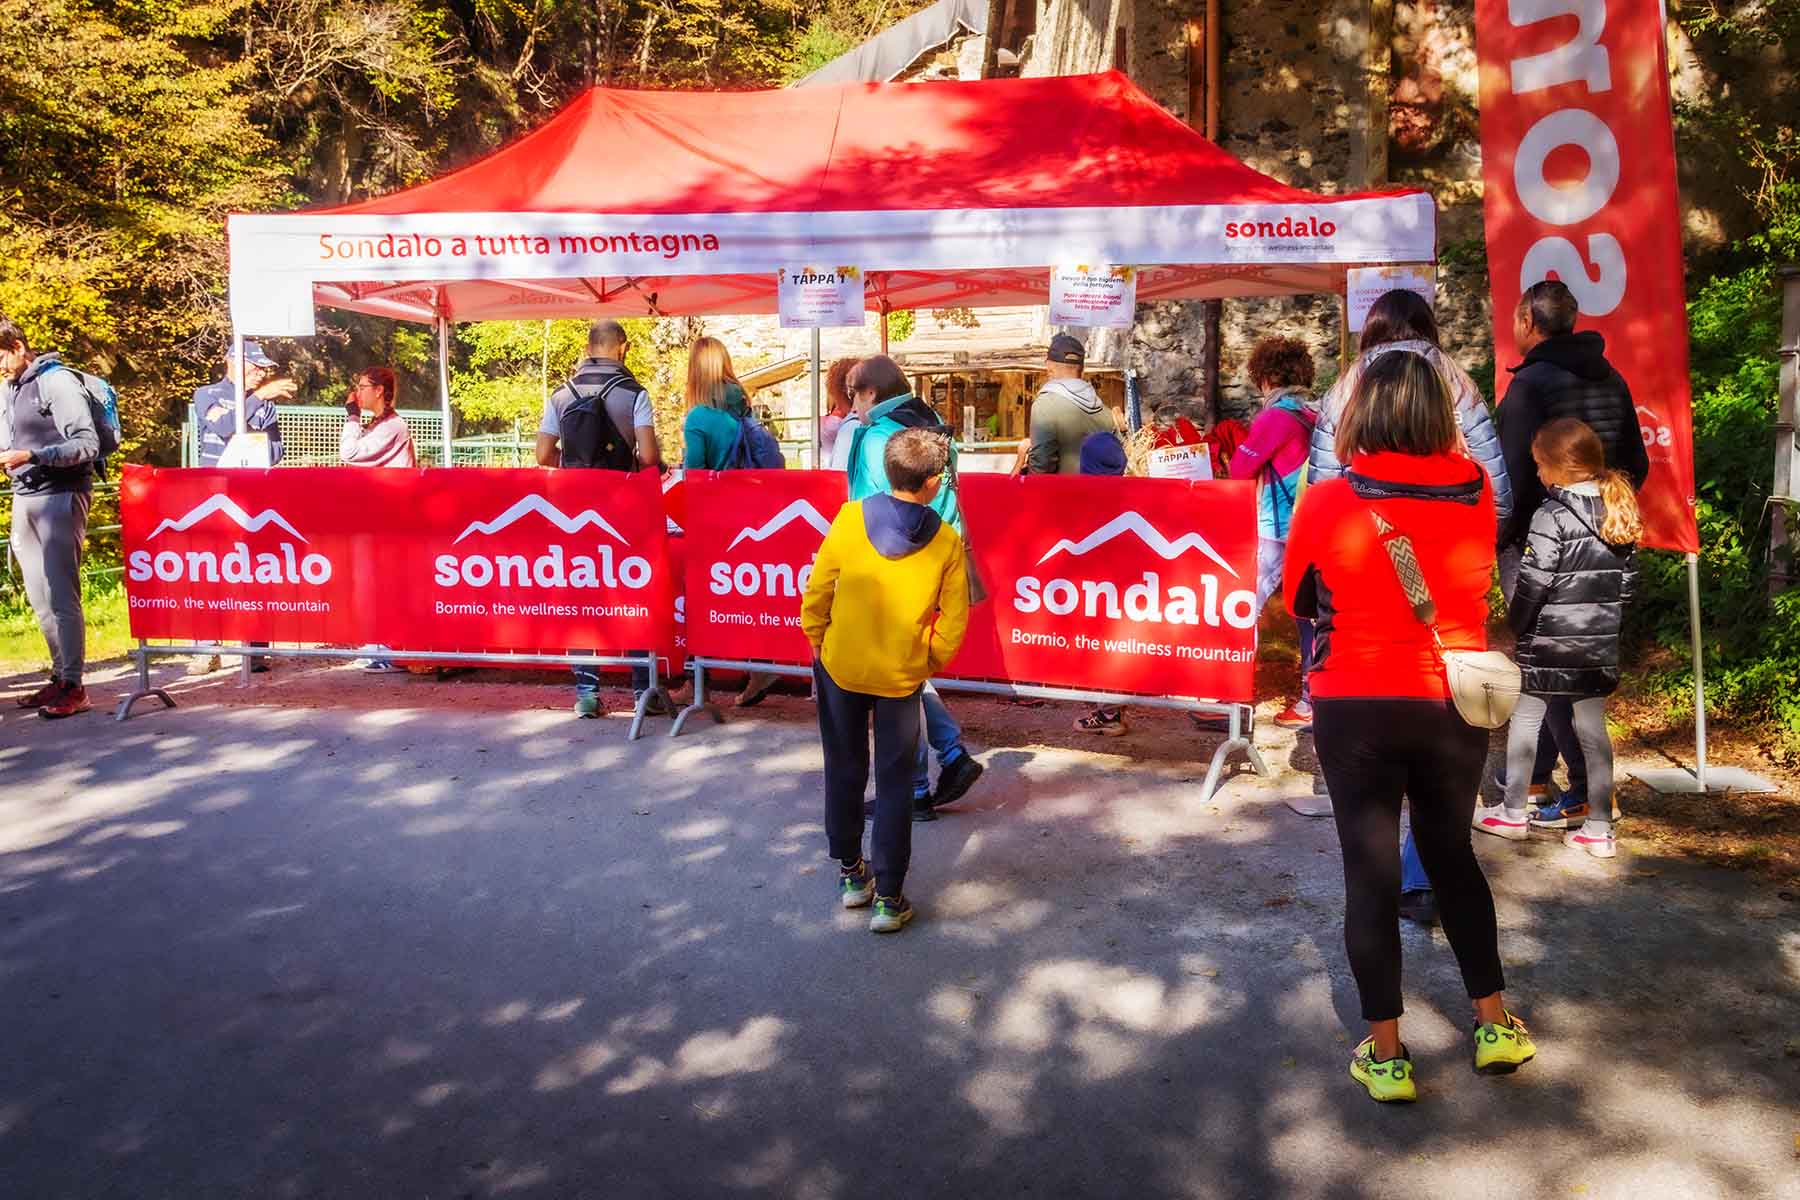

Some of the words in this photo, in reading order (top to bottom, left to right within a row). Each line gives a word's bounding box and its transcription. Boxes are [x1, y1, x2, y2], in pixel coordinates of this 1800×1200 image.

[1225, 216, 1336, 238] sondalo
[319, 233, 442, 259] Sondalo
[451, 238, 467, 256] a
[475, 233, 550, 256] tutta
[559, 231, 720, 259] montagna
[792, 274, 835, 285] TAPPA
[839, 274, 845, 284] 1
[1158, 452, 1189, 463] TAPPA
[129, 542, 332, 585] sondalo
[434, 544, 652, 589] sondalo
[184, 597, 205, 609] the
[207, 597, 264, 611] wellness
[266, 600, 331, 612] mountain
[435, 601, 489, 616] Bormio,
[492, 601, 515, 615] the
[518, 601, 578, 616] wellness
[581, 603, 649, 617] mountain
[1013, 571, 1257, 629] sondalo
[709, 609, 756, 626] Bormio,
[759, 612, 780, 626] the
[1011, 628, 1071, 649] Bormio,
[1075, 635, 1100, 650] the
[1104, 637, 1172, 657] wellness
